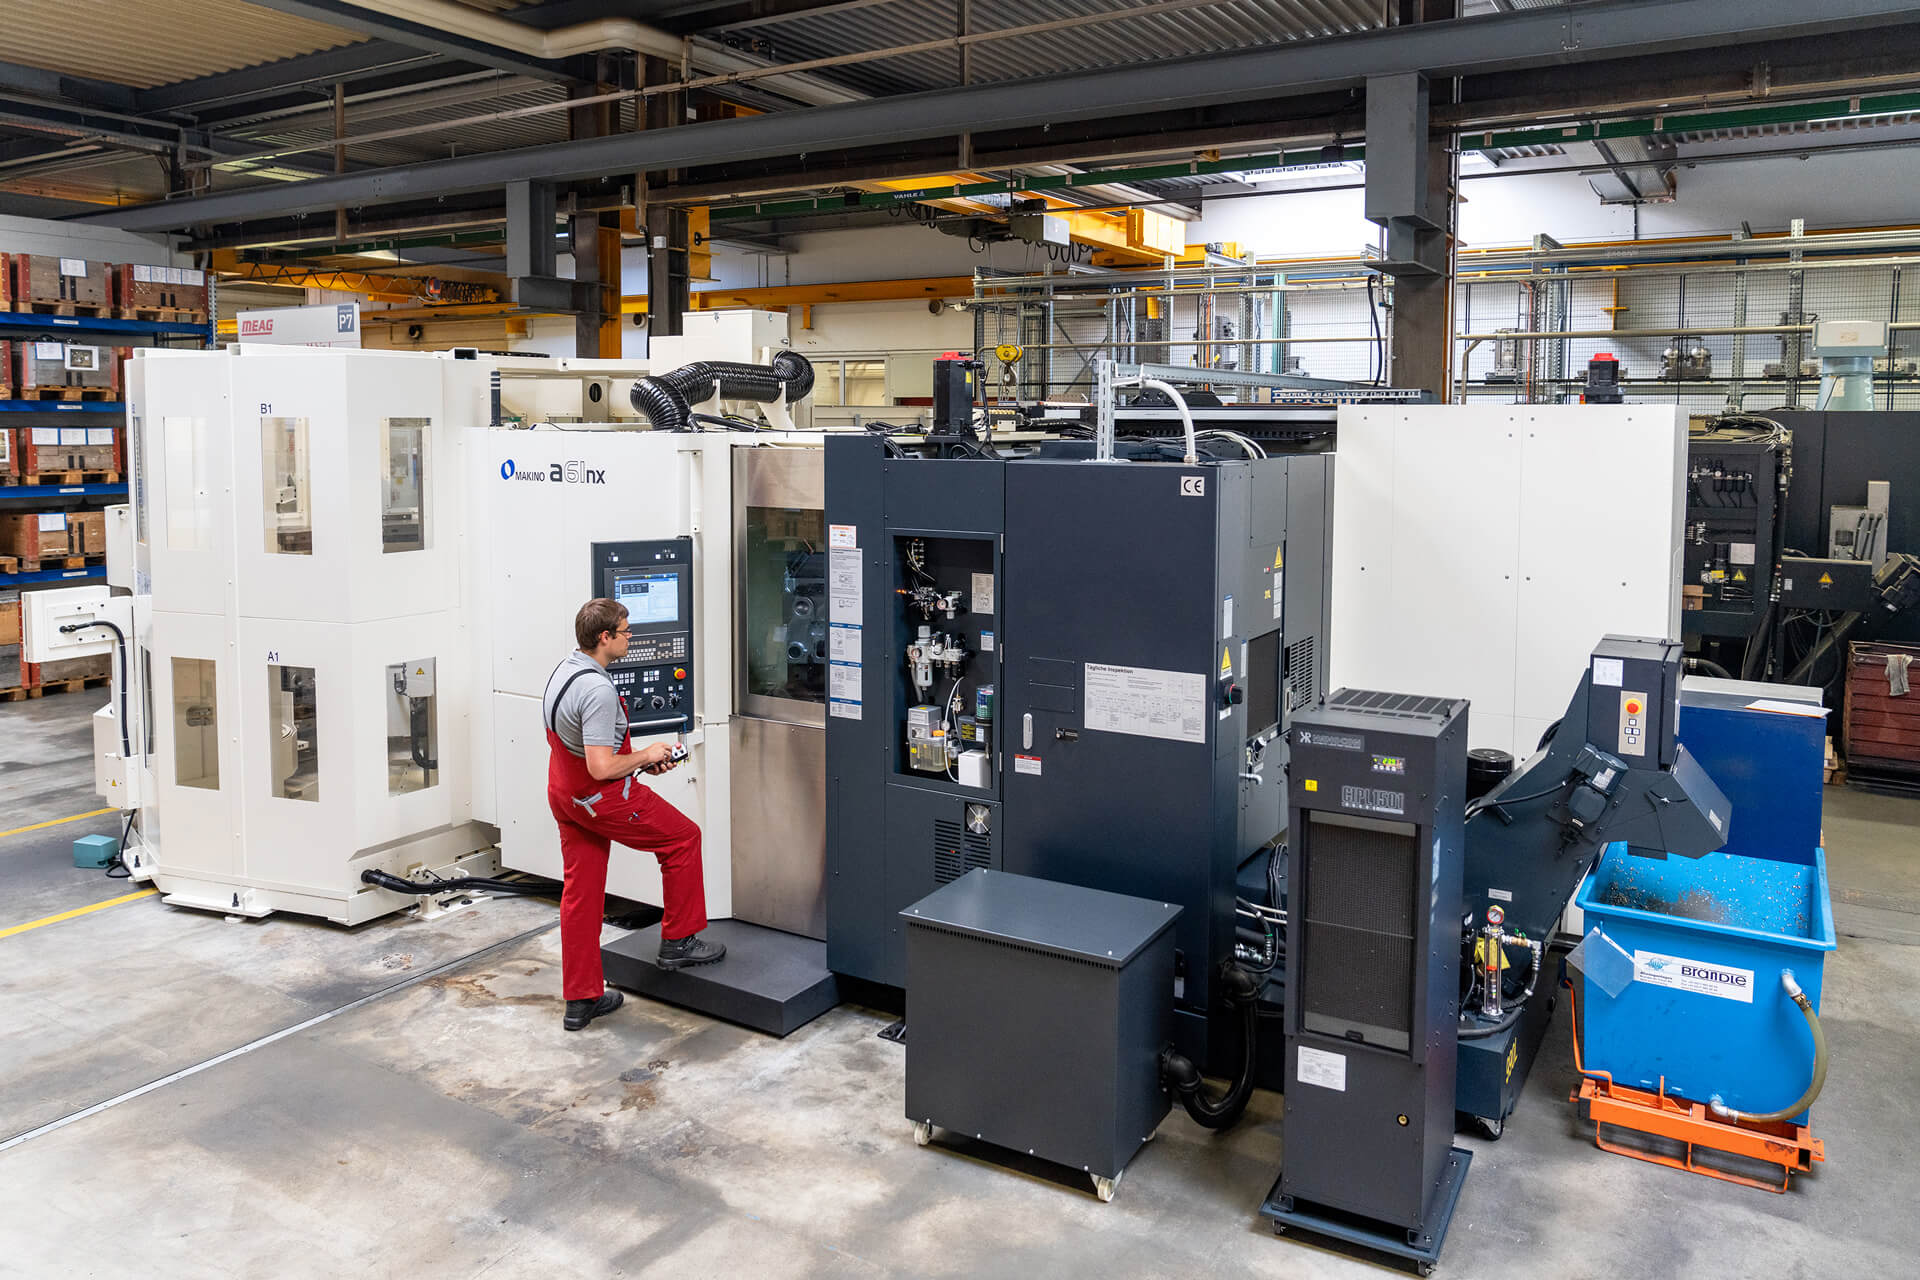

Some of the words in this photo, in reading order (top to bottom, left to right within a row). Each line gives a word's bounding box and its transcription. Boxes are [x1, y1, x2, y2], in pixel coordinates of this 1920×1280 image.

[339, 314, 353, 329] P7
[260, 403, 272, 414] B1
[515, 471, 545, 481] MAKINO
[267, 651, 279, 662] A1
